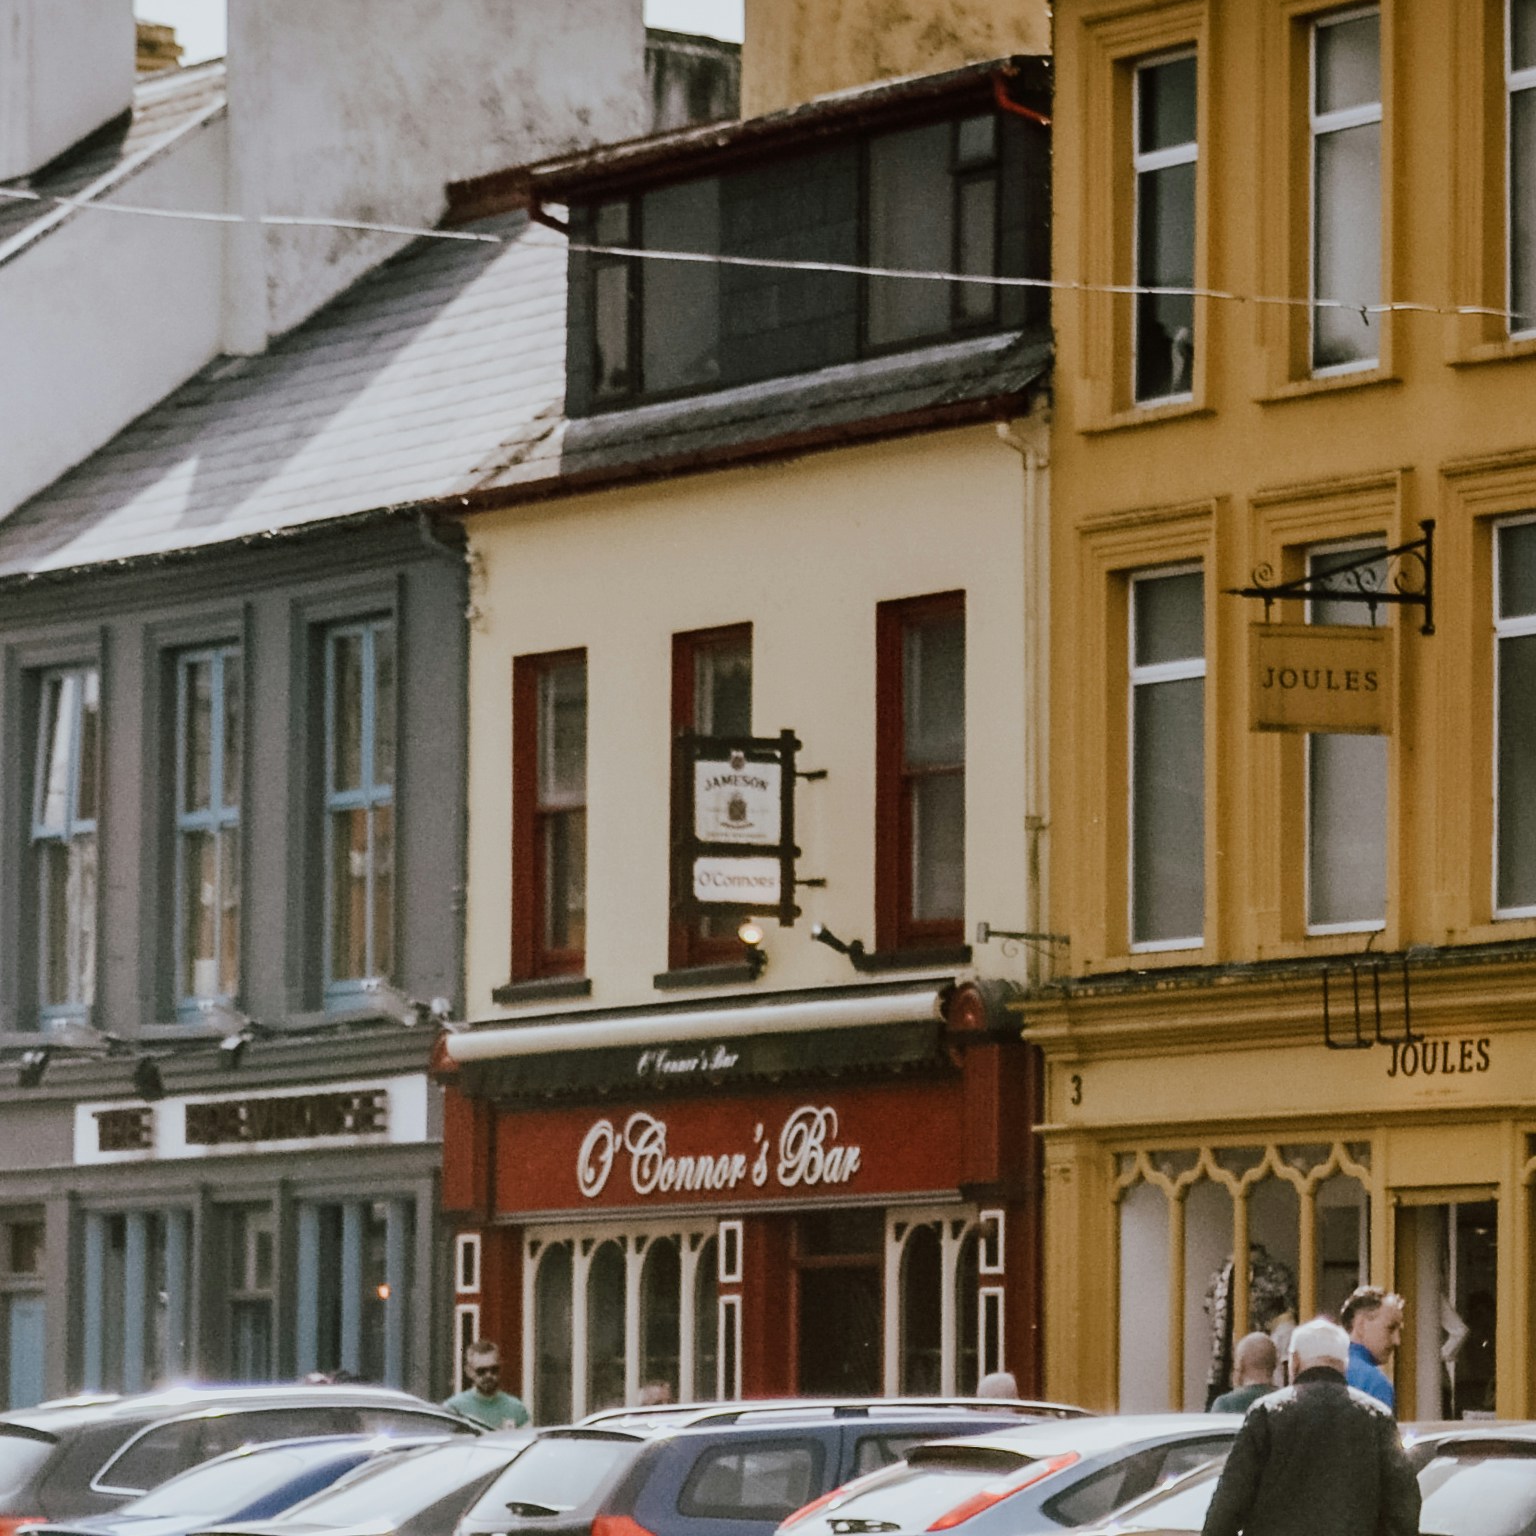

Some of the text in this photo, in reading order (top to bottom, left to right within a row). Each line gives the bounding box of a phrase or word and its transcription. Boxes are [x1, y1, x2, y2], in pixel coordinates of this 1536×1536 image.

[1262, 667, 1379, 692] JOULES
[704, 773, 769, 792] JAMESON
[1386, 1037, 1491, 1078] JOULES
[1070, 1074, 1083, 1106] 3
[576, 1104, 862, 1198] O'Connor's Bar
